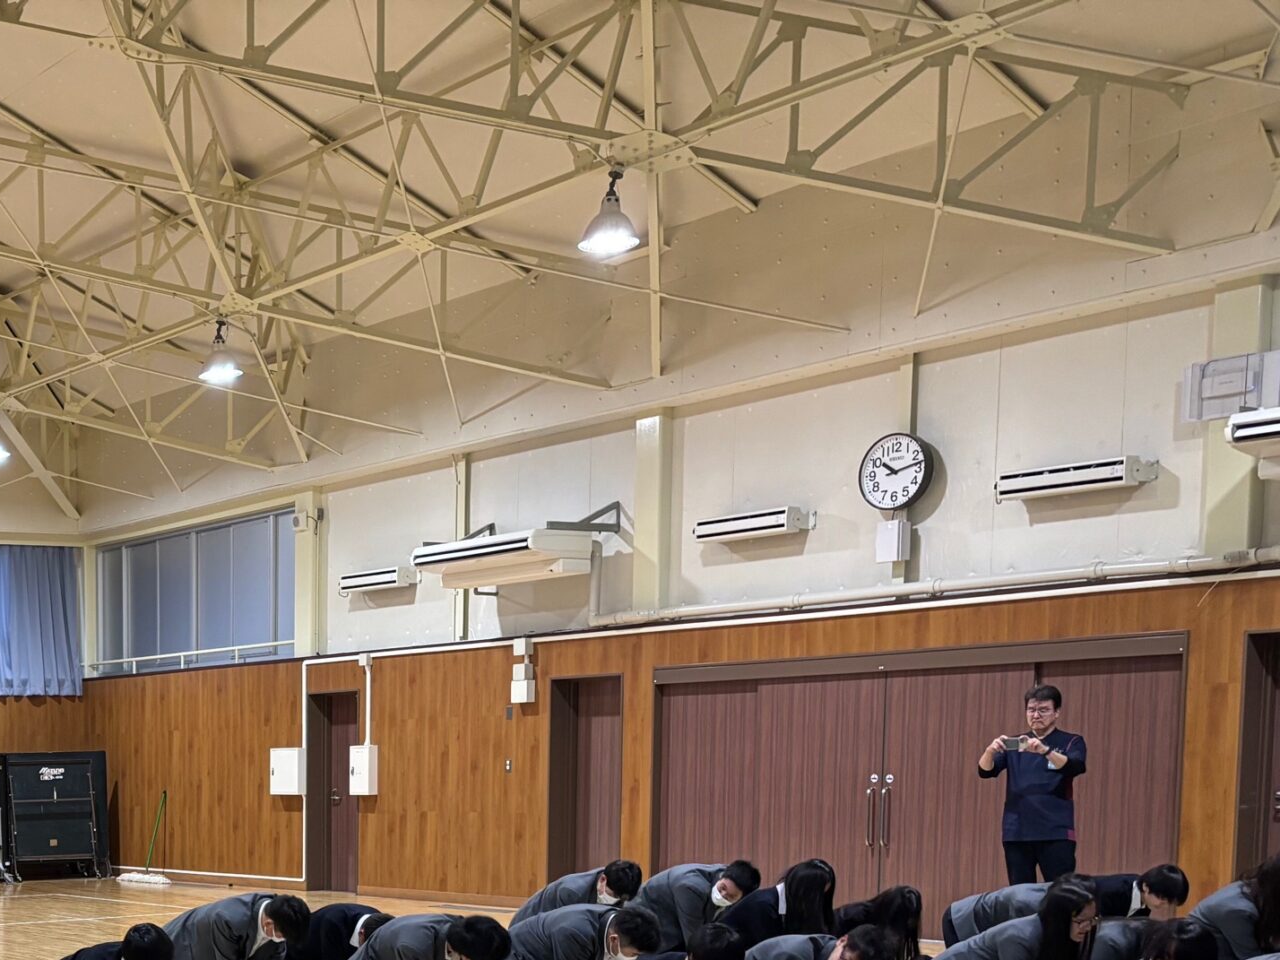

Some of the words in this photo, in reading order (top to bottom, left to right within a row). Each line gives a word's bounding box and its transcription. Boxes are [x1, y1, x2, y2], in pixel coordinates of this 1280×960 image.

[882, 446, 890, 458] 11
[891, 441, 902, 453] 12
[912, 449, 920, 461] 2
[872, 457, 882, 469] 10
[914, 462, 922, 474] 3
[869, 470, 877, 482] 9
[910, 475, 918, 486] 4
[872, 481, 880, 493] 8
[902, 486, 910, 497] 5
[880, 489, 888, 501] 7
[890, 491, 898, 502] 6
